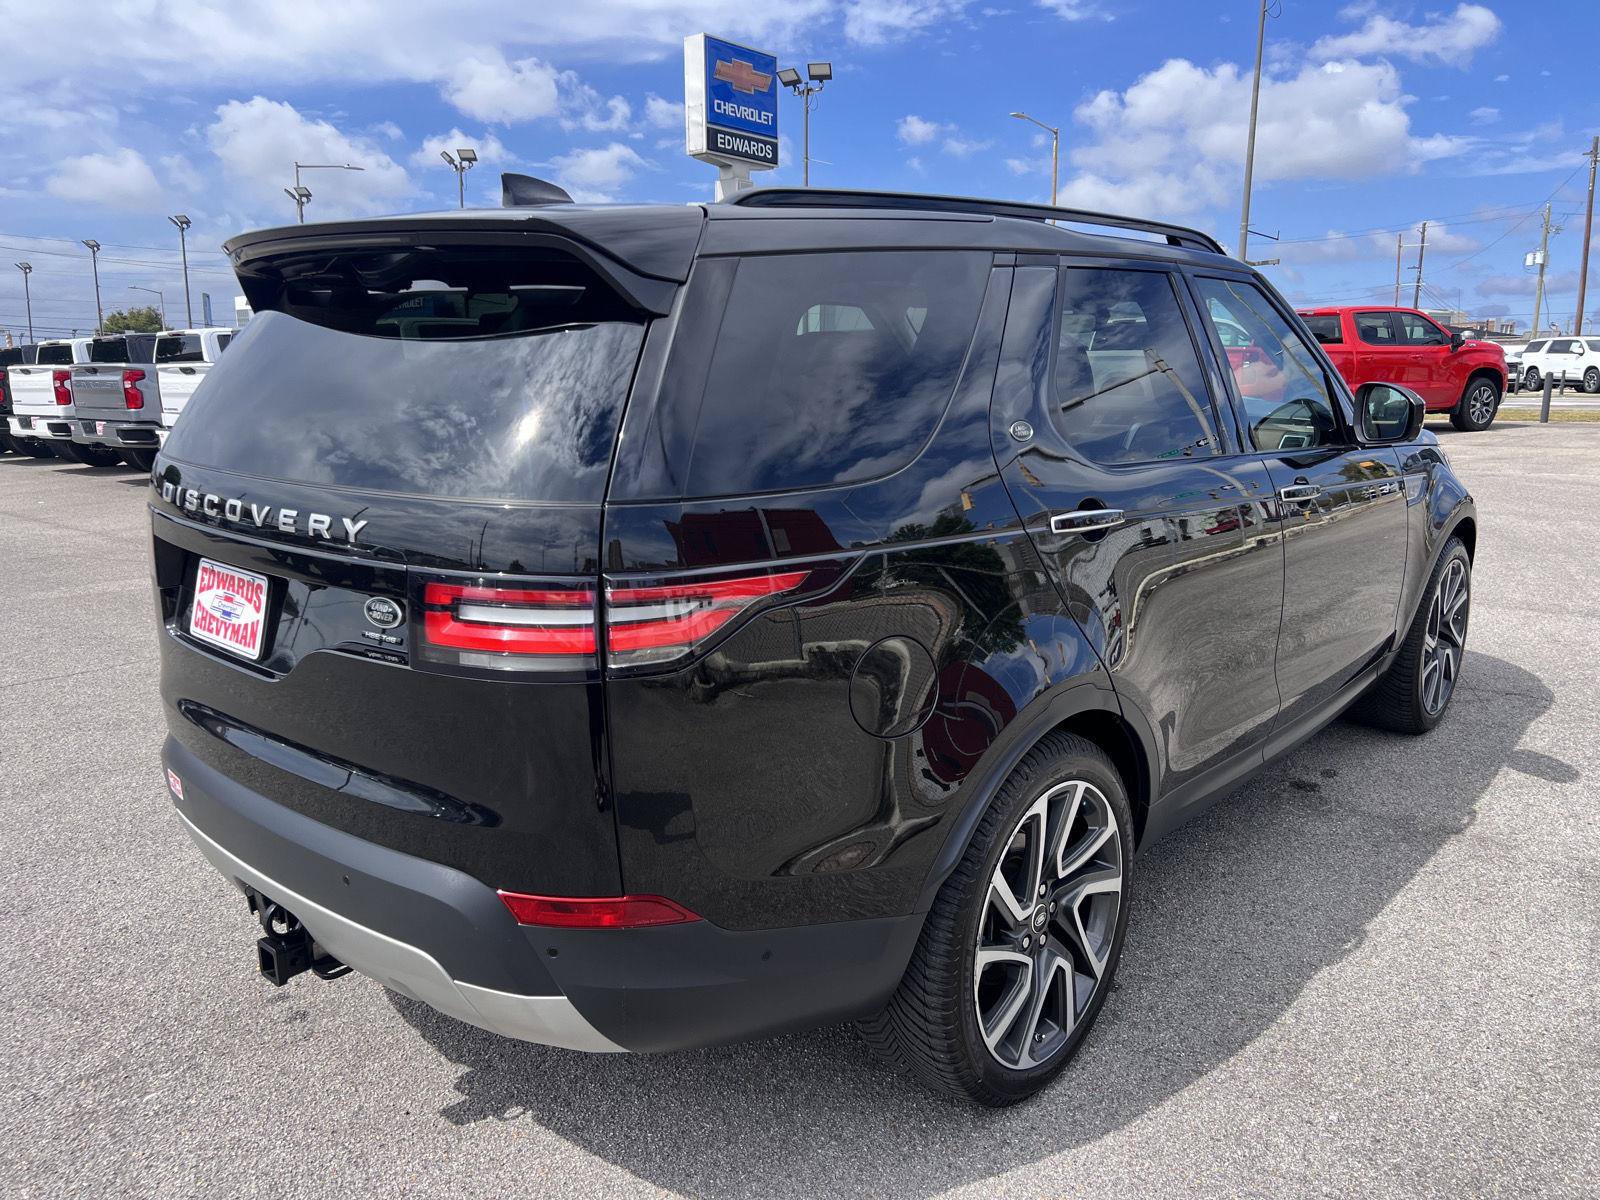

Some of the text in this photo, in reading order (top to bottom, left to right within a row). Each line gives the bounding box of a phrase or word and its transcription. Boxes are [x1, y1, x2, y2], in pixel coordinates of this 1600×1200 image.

[714, 99, 773, 125] CHEVROLET
[717, 133, 773, 158] EDWARDS
[162, 481, 368, 543] DISCOVERY
[199, 566, 263, 614] EDWARDS
[371, 602, 389, 612] LAND
[371, 611, 393, 622] ROVER
[194, 600, 260, 650] CHEVYMAN
